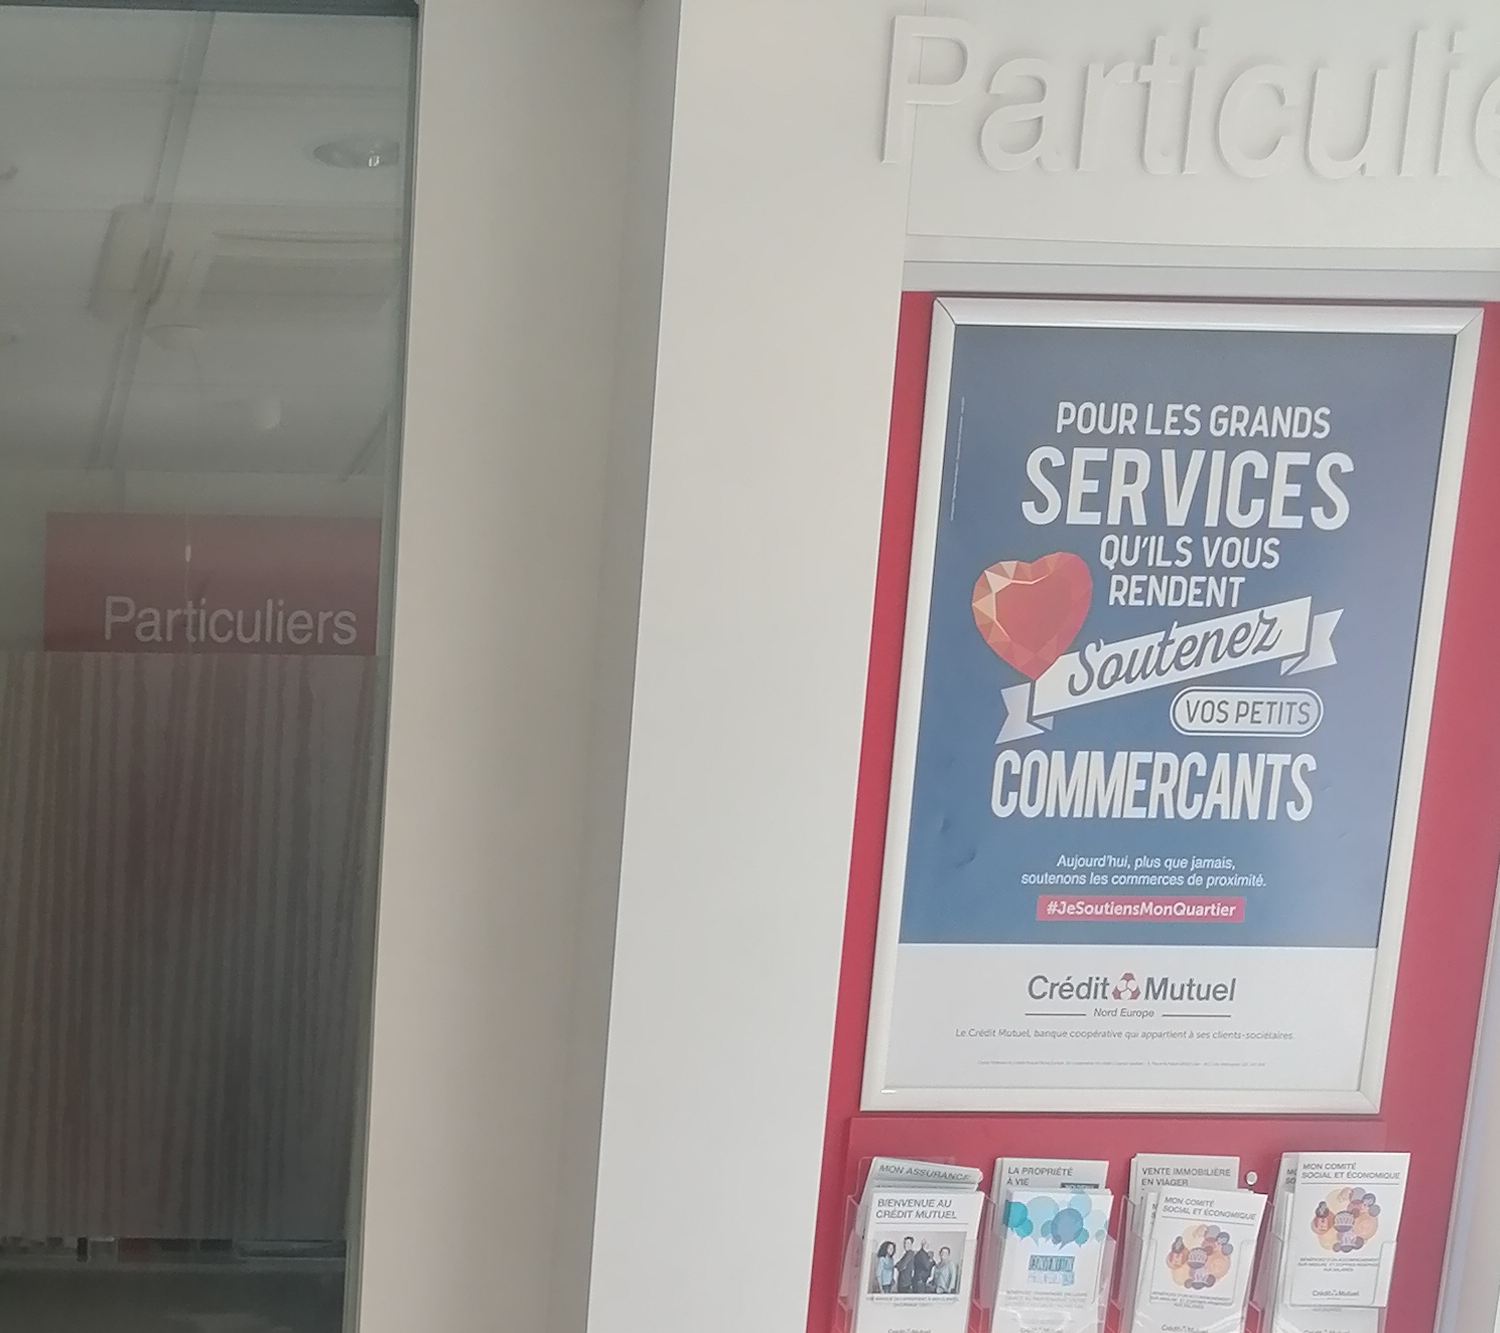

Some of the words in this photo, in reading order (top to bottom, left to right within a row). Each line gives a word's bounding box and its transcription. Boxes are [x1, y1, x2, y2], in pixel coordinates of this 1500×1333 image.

[1056, 401, 1137, 436] POUR
[1144, 403, 1202, 437] LES
[1209, 405, 1332, 440] GRANDS
[1020, 445, 1355, 531] SERVICES
[1099, 534, 1193, 571] QU'ILS
[1201, 536, 1281, 569] VOUS
[1108, 574, 1246, 609] RENDENT
[104, 595, 358, 646] Particuliers
[1067, 609, 1284, 698] Soutenez
[1184, 698, 1230, 724] VOS
[1234, 699, 1312, 726] PETITS
[991, 750, 1319, 822] COMMERCANTS
[1056, 854, 1131, 871] Aujourd'hui,
[1134, 855, 1161, 871] plus
[1164, 857, 1189, 871] que
[1191, 855, 1236, 871] jamais,
[1020, 872, 1087, 886] soutenons
[1089, 872, 1109, 886] les
[1111, 873, 1184, 887] commerces
[1187, 873, 1203, 887] de
[1206, 872, 1267, 889] proximité.
[1046, 900, 1237, 918] #JeSoutiensMonQuartier
[1027, 974, 1111, 1002] Crédit
[1144, 976, 1237, 1003] Mutuel
[1093, 1007, 1118, 1018] Nord
[1120, 1008, 1155, 1020] Europe
[955, 1028, 967, 1038] Le
[968, 1028, 997, 1038] Crédit
[1034, 1028, 1068, 1040] banque
[1069, 1028, 1123, 1040] coopérative
[1124, 1030, 1140, 1040] qui
[1141, 1029, 1187, 1041] appartient
[1196, 1031, 1211, 1040] ses
[879, 1164, 904, 1174] MON
[1008, 1167, 1019, 1175] LA
[1021, 1166, 1074, 1177] PROPRIÉTÉ
[1142, 1167, 1171, 1176] VENTE
[1173, 1166, 1231, 1177] IMMOBILIÈRE
[1324, 1162, 1356, 1170] COMITÉ
[1015, 1178, 1030, 1186] VIE
[1141, 1178, 1154, 1186] EN
[1156, 1178, 1189, 1187] VIAGER
[1302, 1171, 1332, 1179] SOCIAL
[1346, 1170, 1401, 1180] ÉCONOMIQUE
[877, 1198, 935, 1208] BIENVENUE
[936, 1199, 952, 1208] AU
[1165, 1196, 1184, 1205] MON
[1185, 1198, 1214, 1207] COMITÉ
[875, 1208, 913, 1219] CRÉDIT
[915, 1210, 957, 1219] MUTUEL
[1162, 1206, 1191, 1215] SOCIAL
[1204, 1208, 1256, 1221] ÉCONOMIQUE
